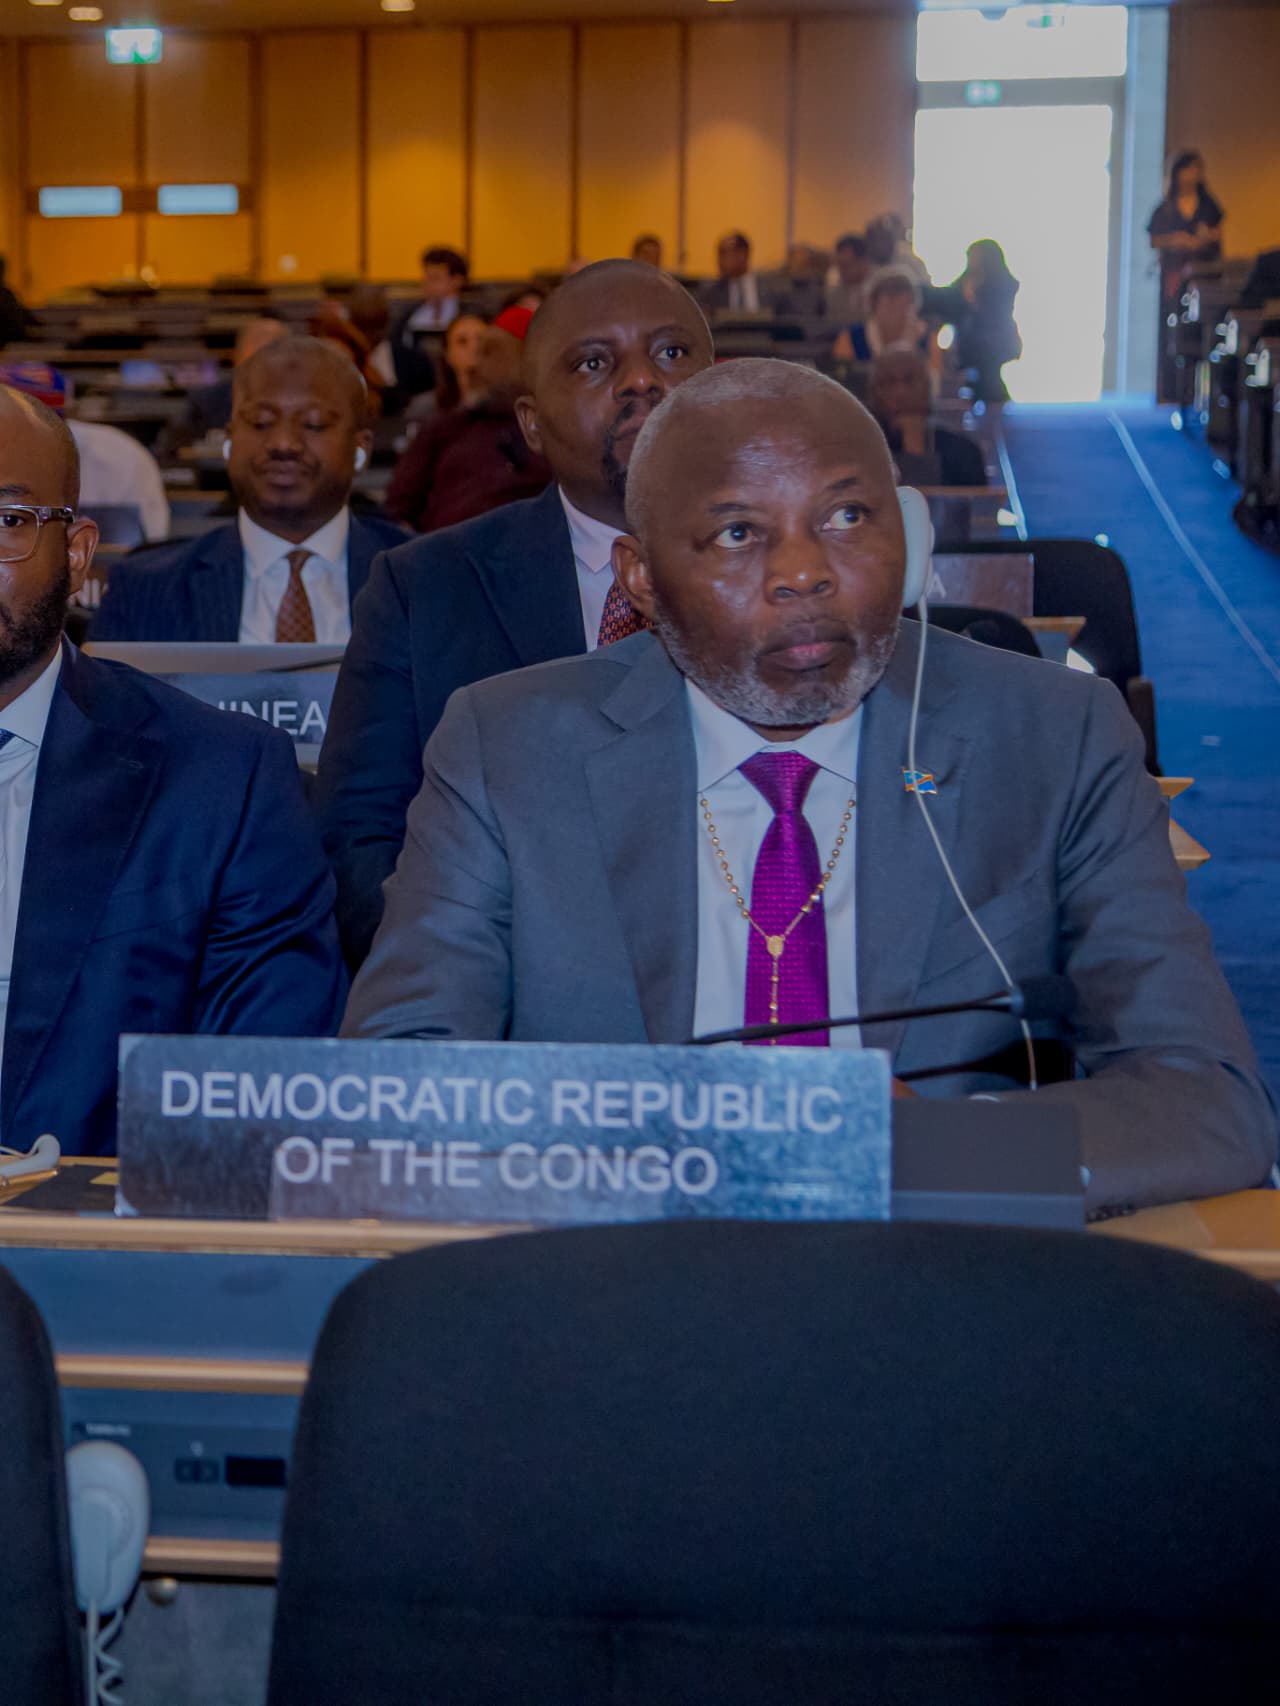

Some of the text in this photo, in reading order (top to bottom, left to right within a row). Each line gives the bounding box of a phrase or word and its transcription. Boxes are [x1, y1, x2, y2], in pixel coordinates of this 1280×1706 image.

[161, 1070, 843, 1133] DEMOCRATIC REPUBLIC
[275, 1136, 718, 1195] OF THE CONGO
